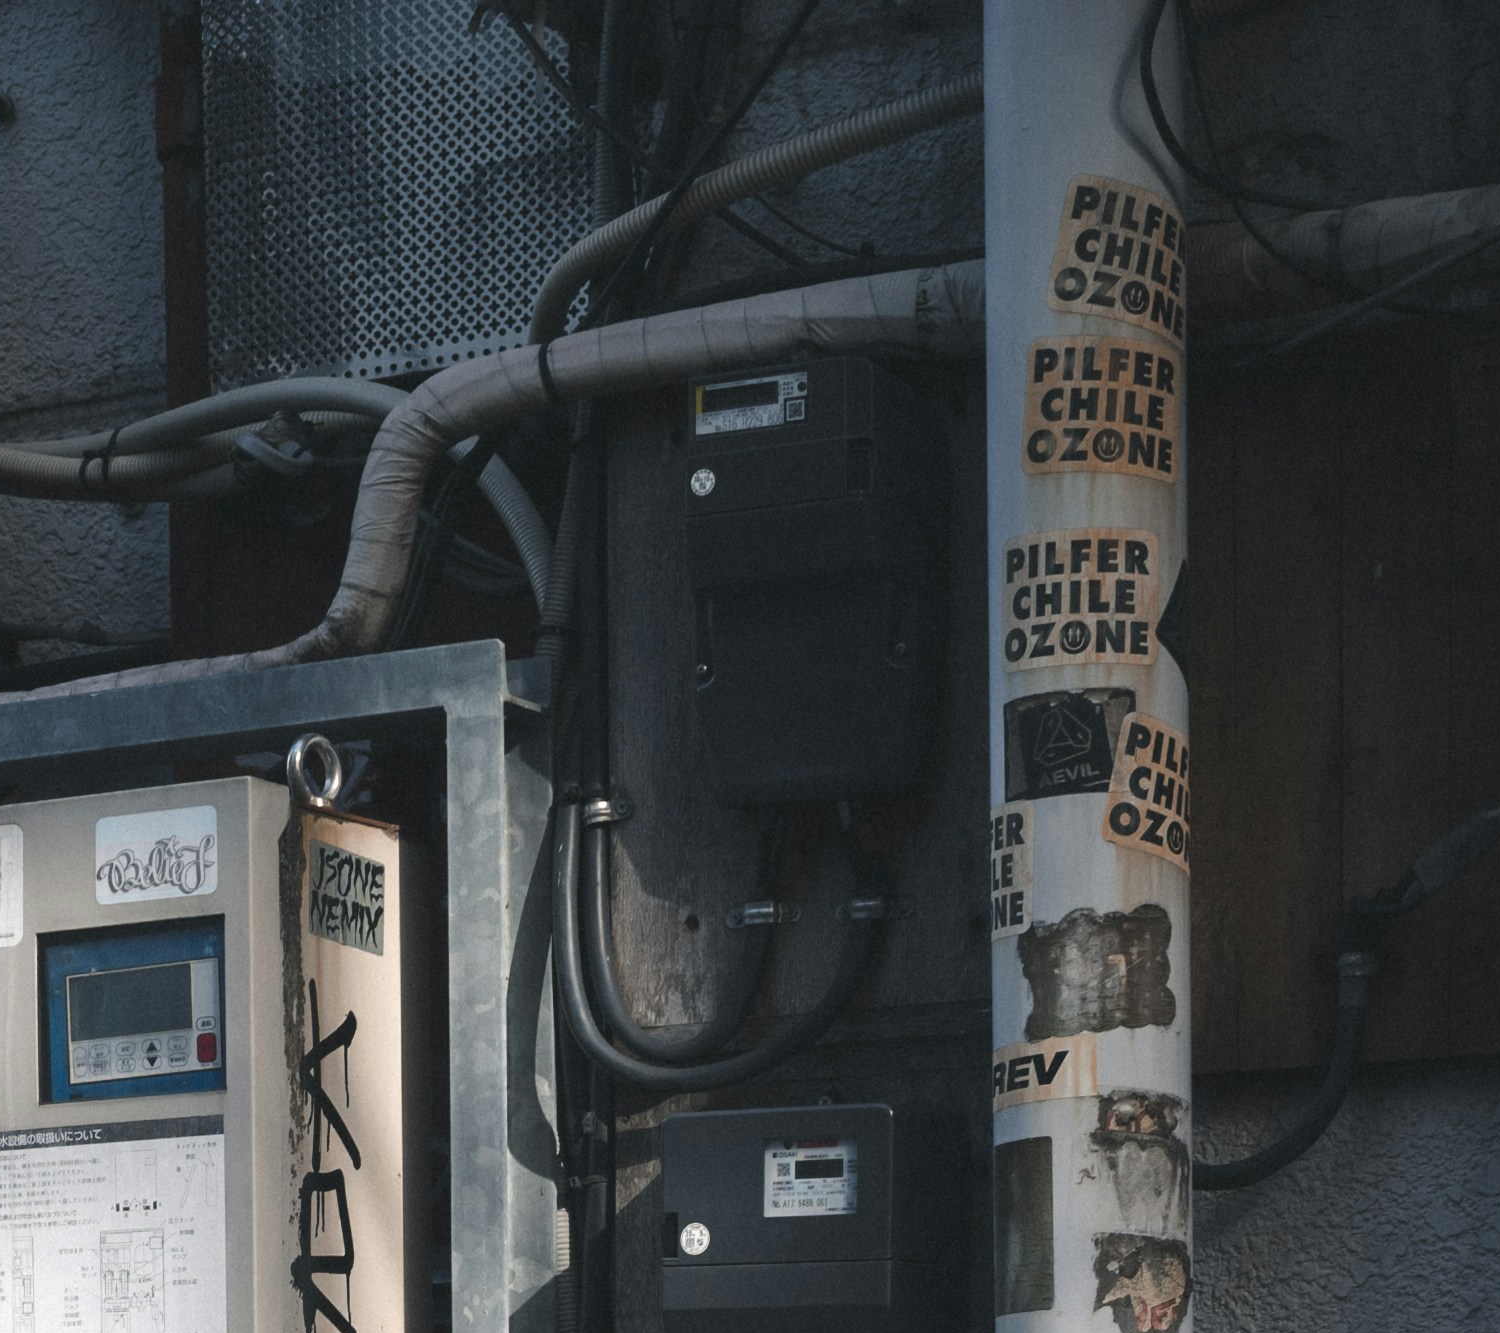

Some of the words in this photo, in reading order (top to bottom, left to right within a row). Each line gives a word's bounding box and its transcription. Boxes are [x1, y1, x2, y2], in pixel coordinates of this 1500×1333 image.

[1075, 228, 1183, 297] CHILE
[1054, 266, 1184, 340] OZONE
[1034, 347, 1174, 395] PILFER
[1041, 387, 1164, 431] CHILE
[1027, 427, 1173, 474] OZONE
[1007, 539, 1150, 584] PILFER
[1012, 577, 1135, 621] CHILE
[1004, 620, 1149, 663] OZONE
[1039, 767, 1100, 790] AEVIL
[312, 890, 385, 948] NEMIX
